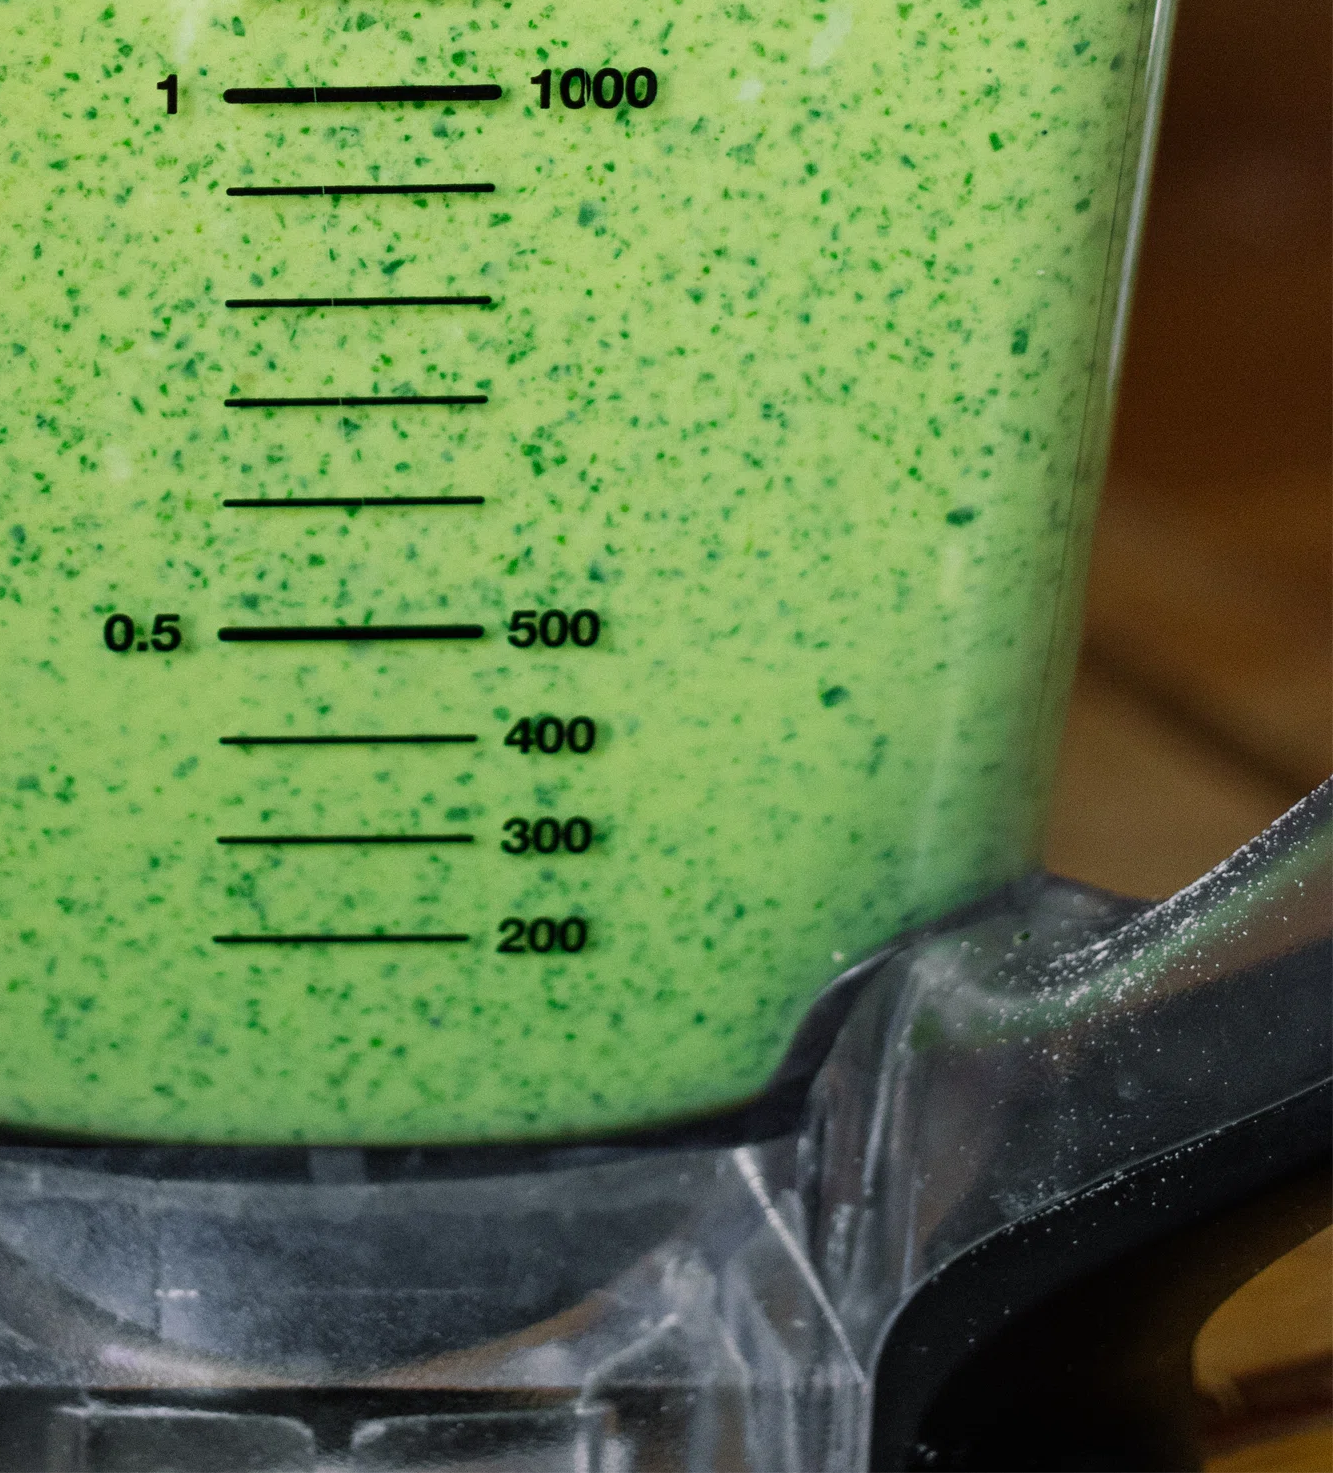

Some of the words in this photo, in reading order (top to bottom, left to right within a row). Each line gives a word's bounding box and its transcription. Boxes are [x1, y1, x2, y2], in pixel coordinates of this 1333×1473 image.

[156, 74, 179, 115] 1
[529, 67, 658, 109] 1000
[103, 613, 182, 652] 0.5
[506, 609, 600, 648] 500
[504, 717, 596, 755] 400
[500, 817, 592, 855] 300
[496, 917, 588, 954] 200
